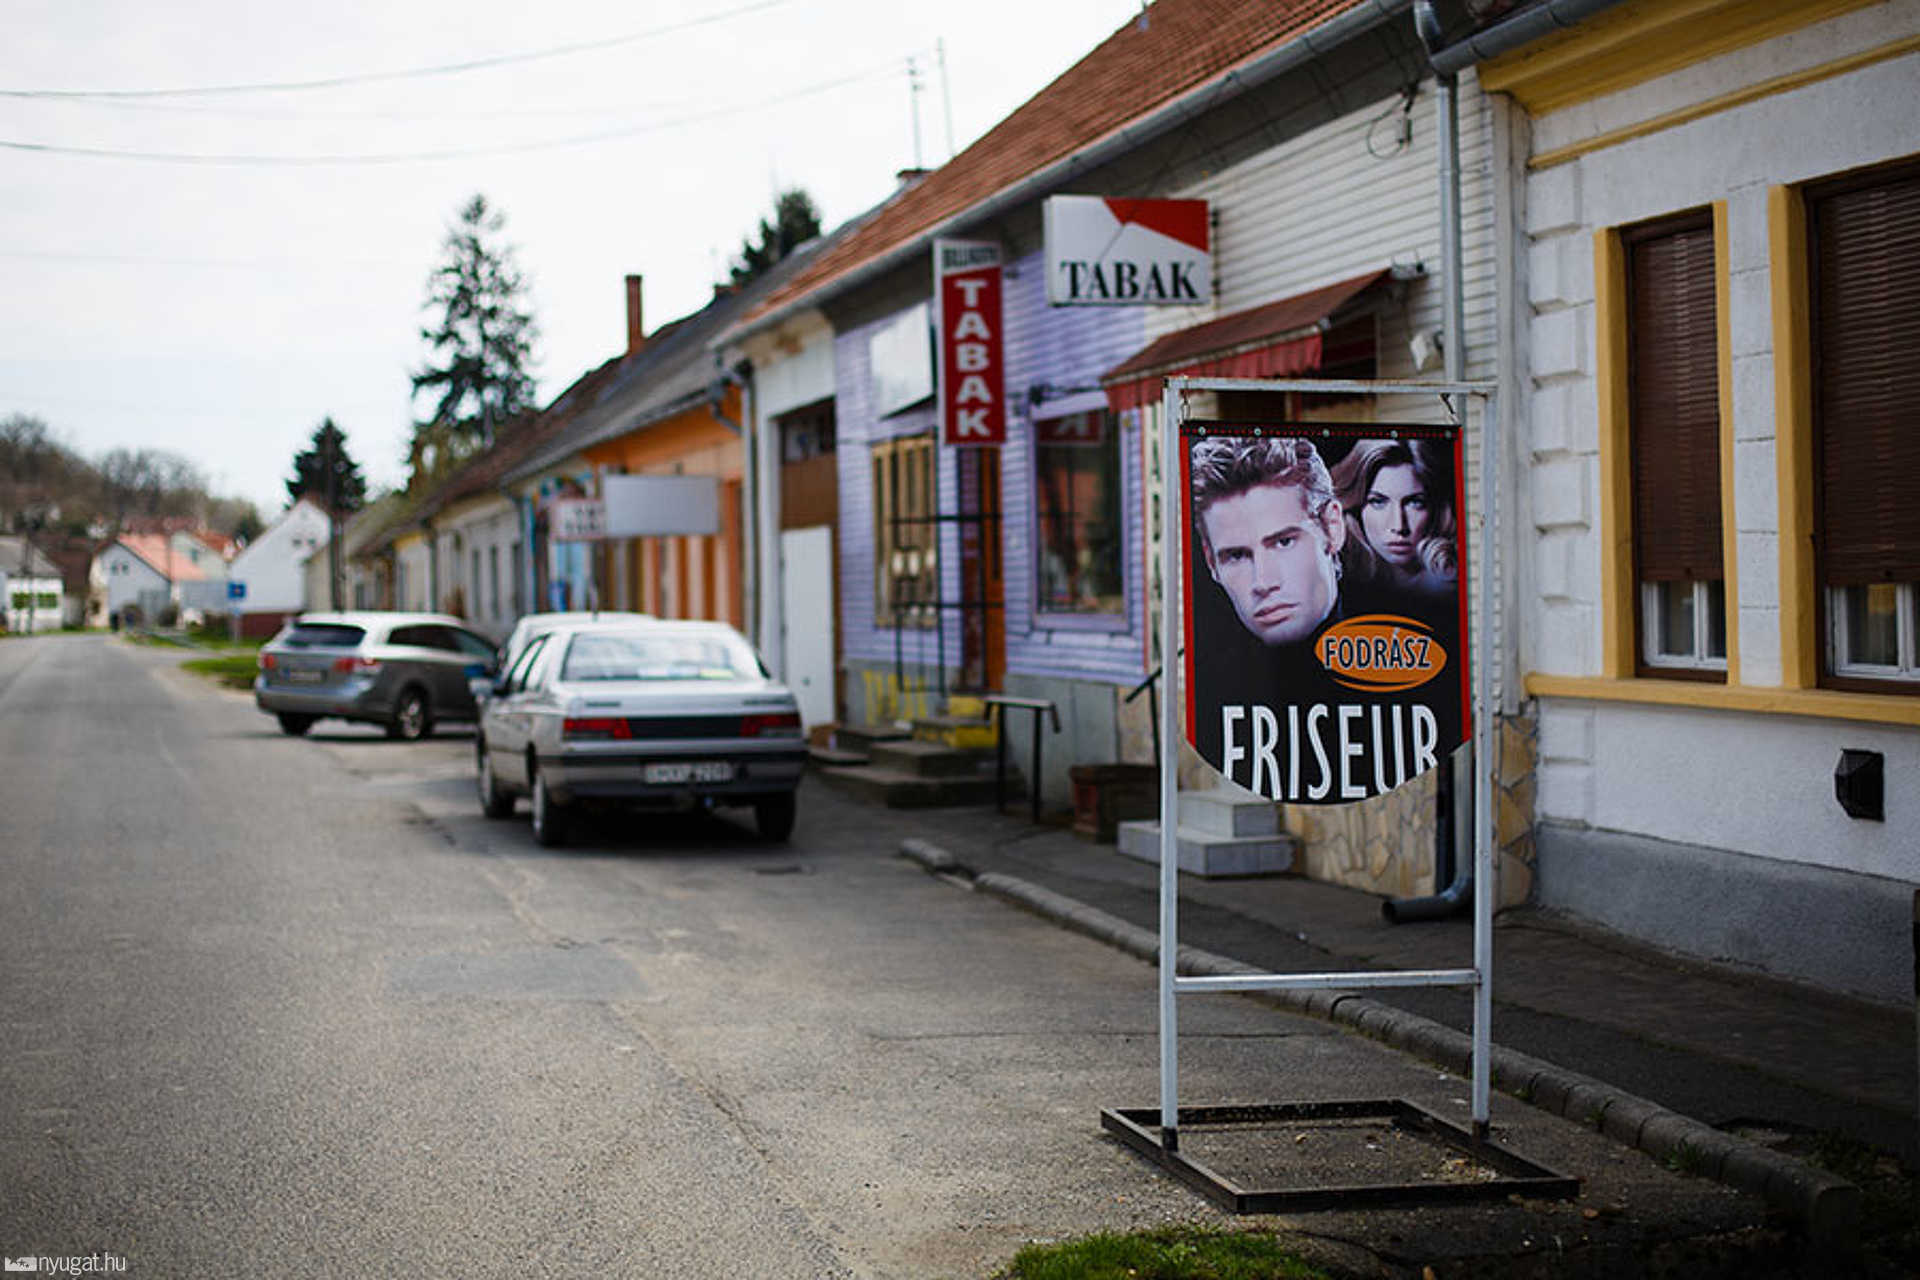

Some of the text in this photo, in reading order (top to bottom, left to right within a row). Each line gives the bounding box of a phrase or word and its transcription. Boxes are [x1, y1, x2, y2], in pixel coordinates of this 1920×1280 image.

[1060, 260, 1198, 300] TABAK
[954, 278, 993, 438] TABAK
[1323, 627, 1432, 670] FODRÁSZ
[1221, 703, 1439, 800] FRISEUR
